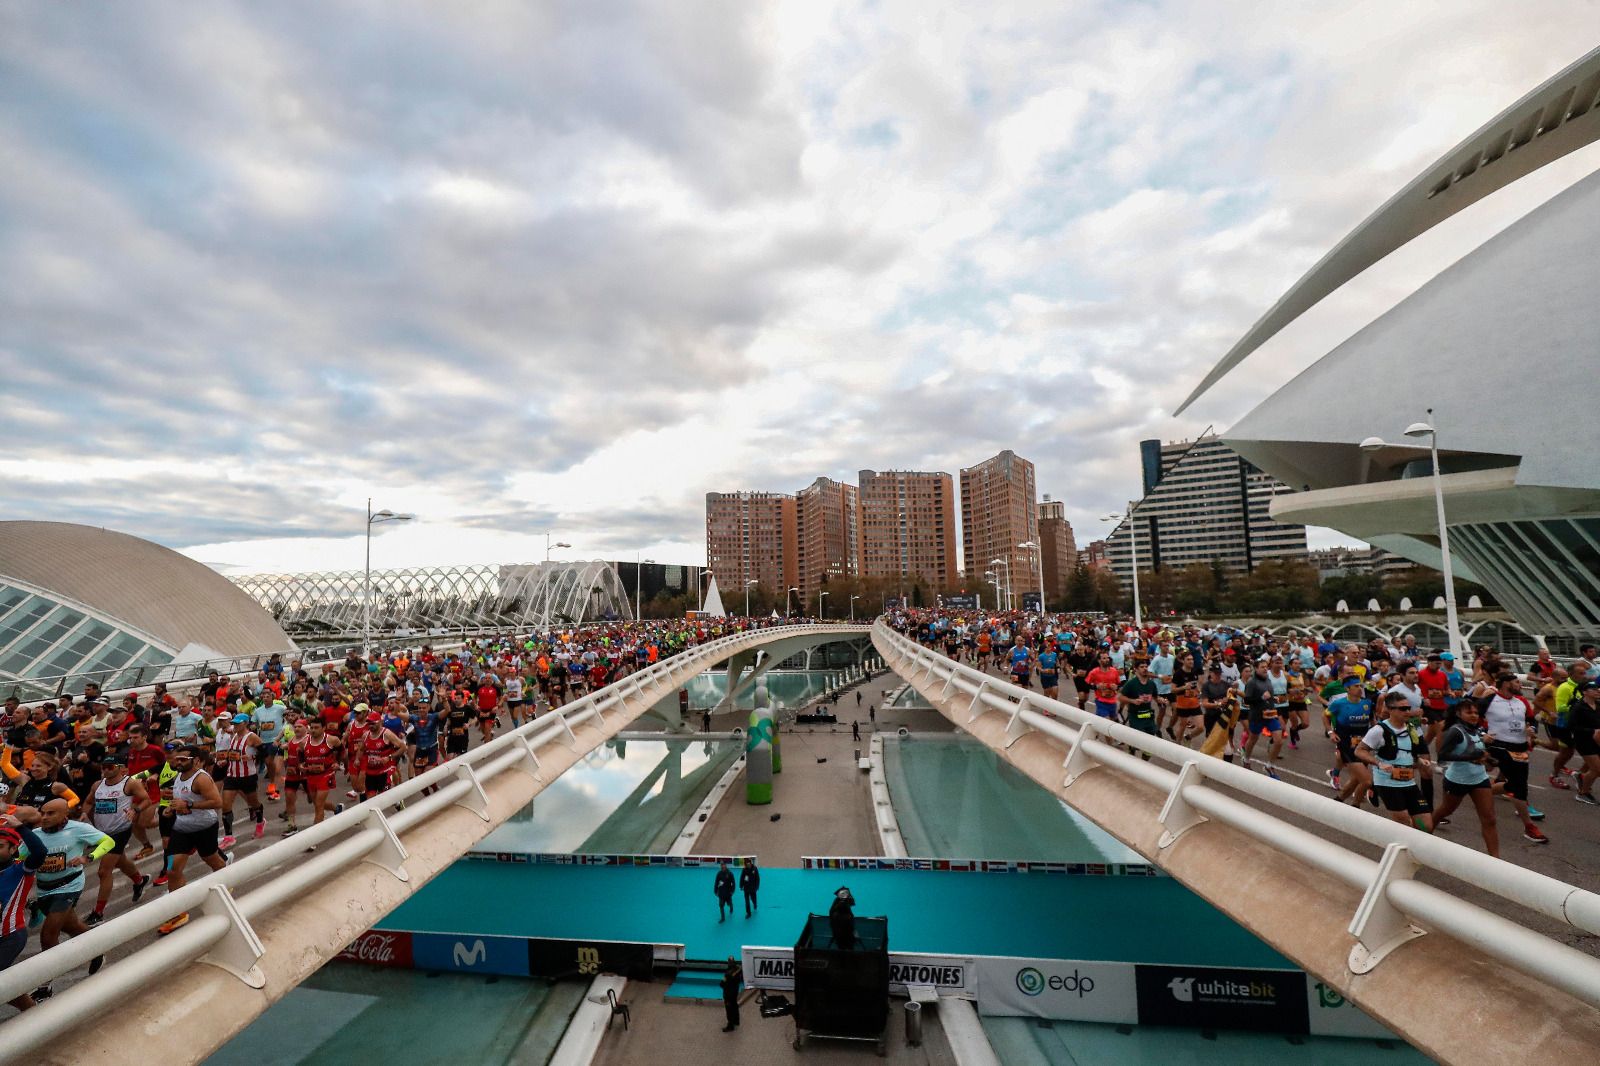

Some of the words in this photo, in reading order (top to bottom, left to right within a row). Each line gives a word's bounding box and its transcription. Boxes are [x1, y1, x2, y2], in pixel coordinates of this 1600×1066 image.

[758, 960, 796, 977] MAR
[888, 964, 961, 985] RATONES
[1048, 968, 1095, 998] edp
[1198, 980, 1276, 998] whitebit
